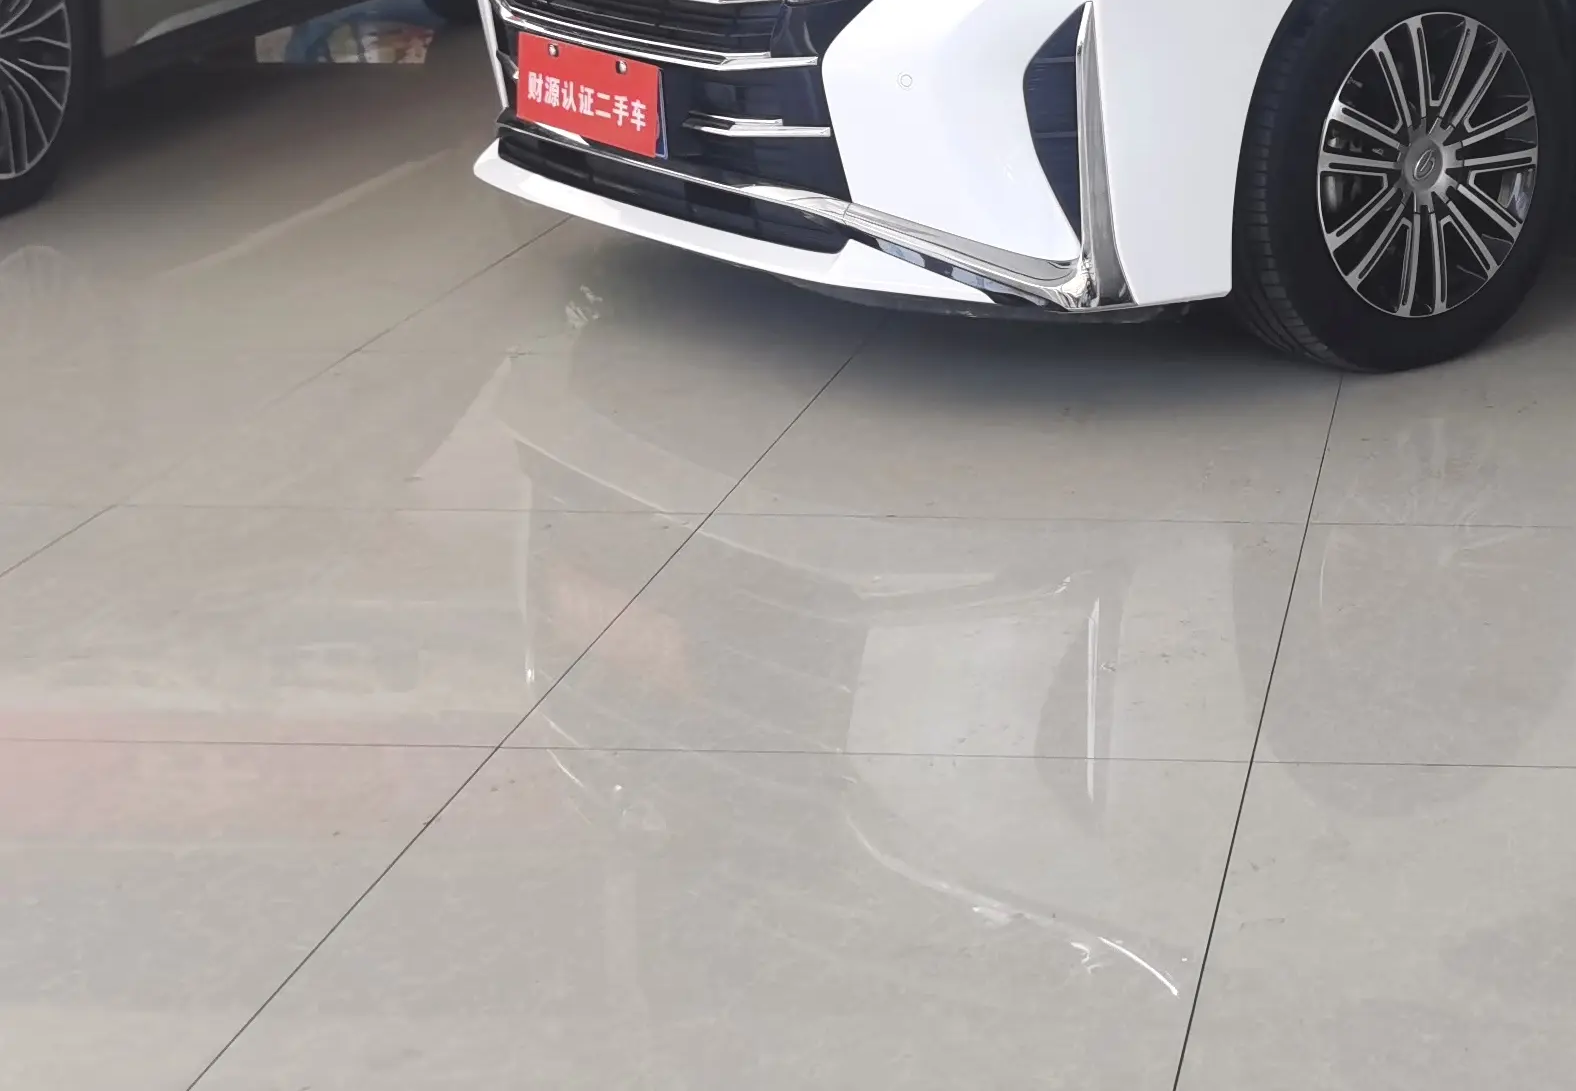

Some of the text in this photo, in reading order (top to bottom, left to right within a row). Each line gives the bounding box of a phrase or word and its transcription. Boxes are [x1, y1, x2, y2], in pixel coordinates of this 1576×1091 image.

[527, 71, 647, 132] 财源认证二手车
